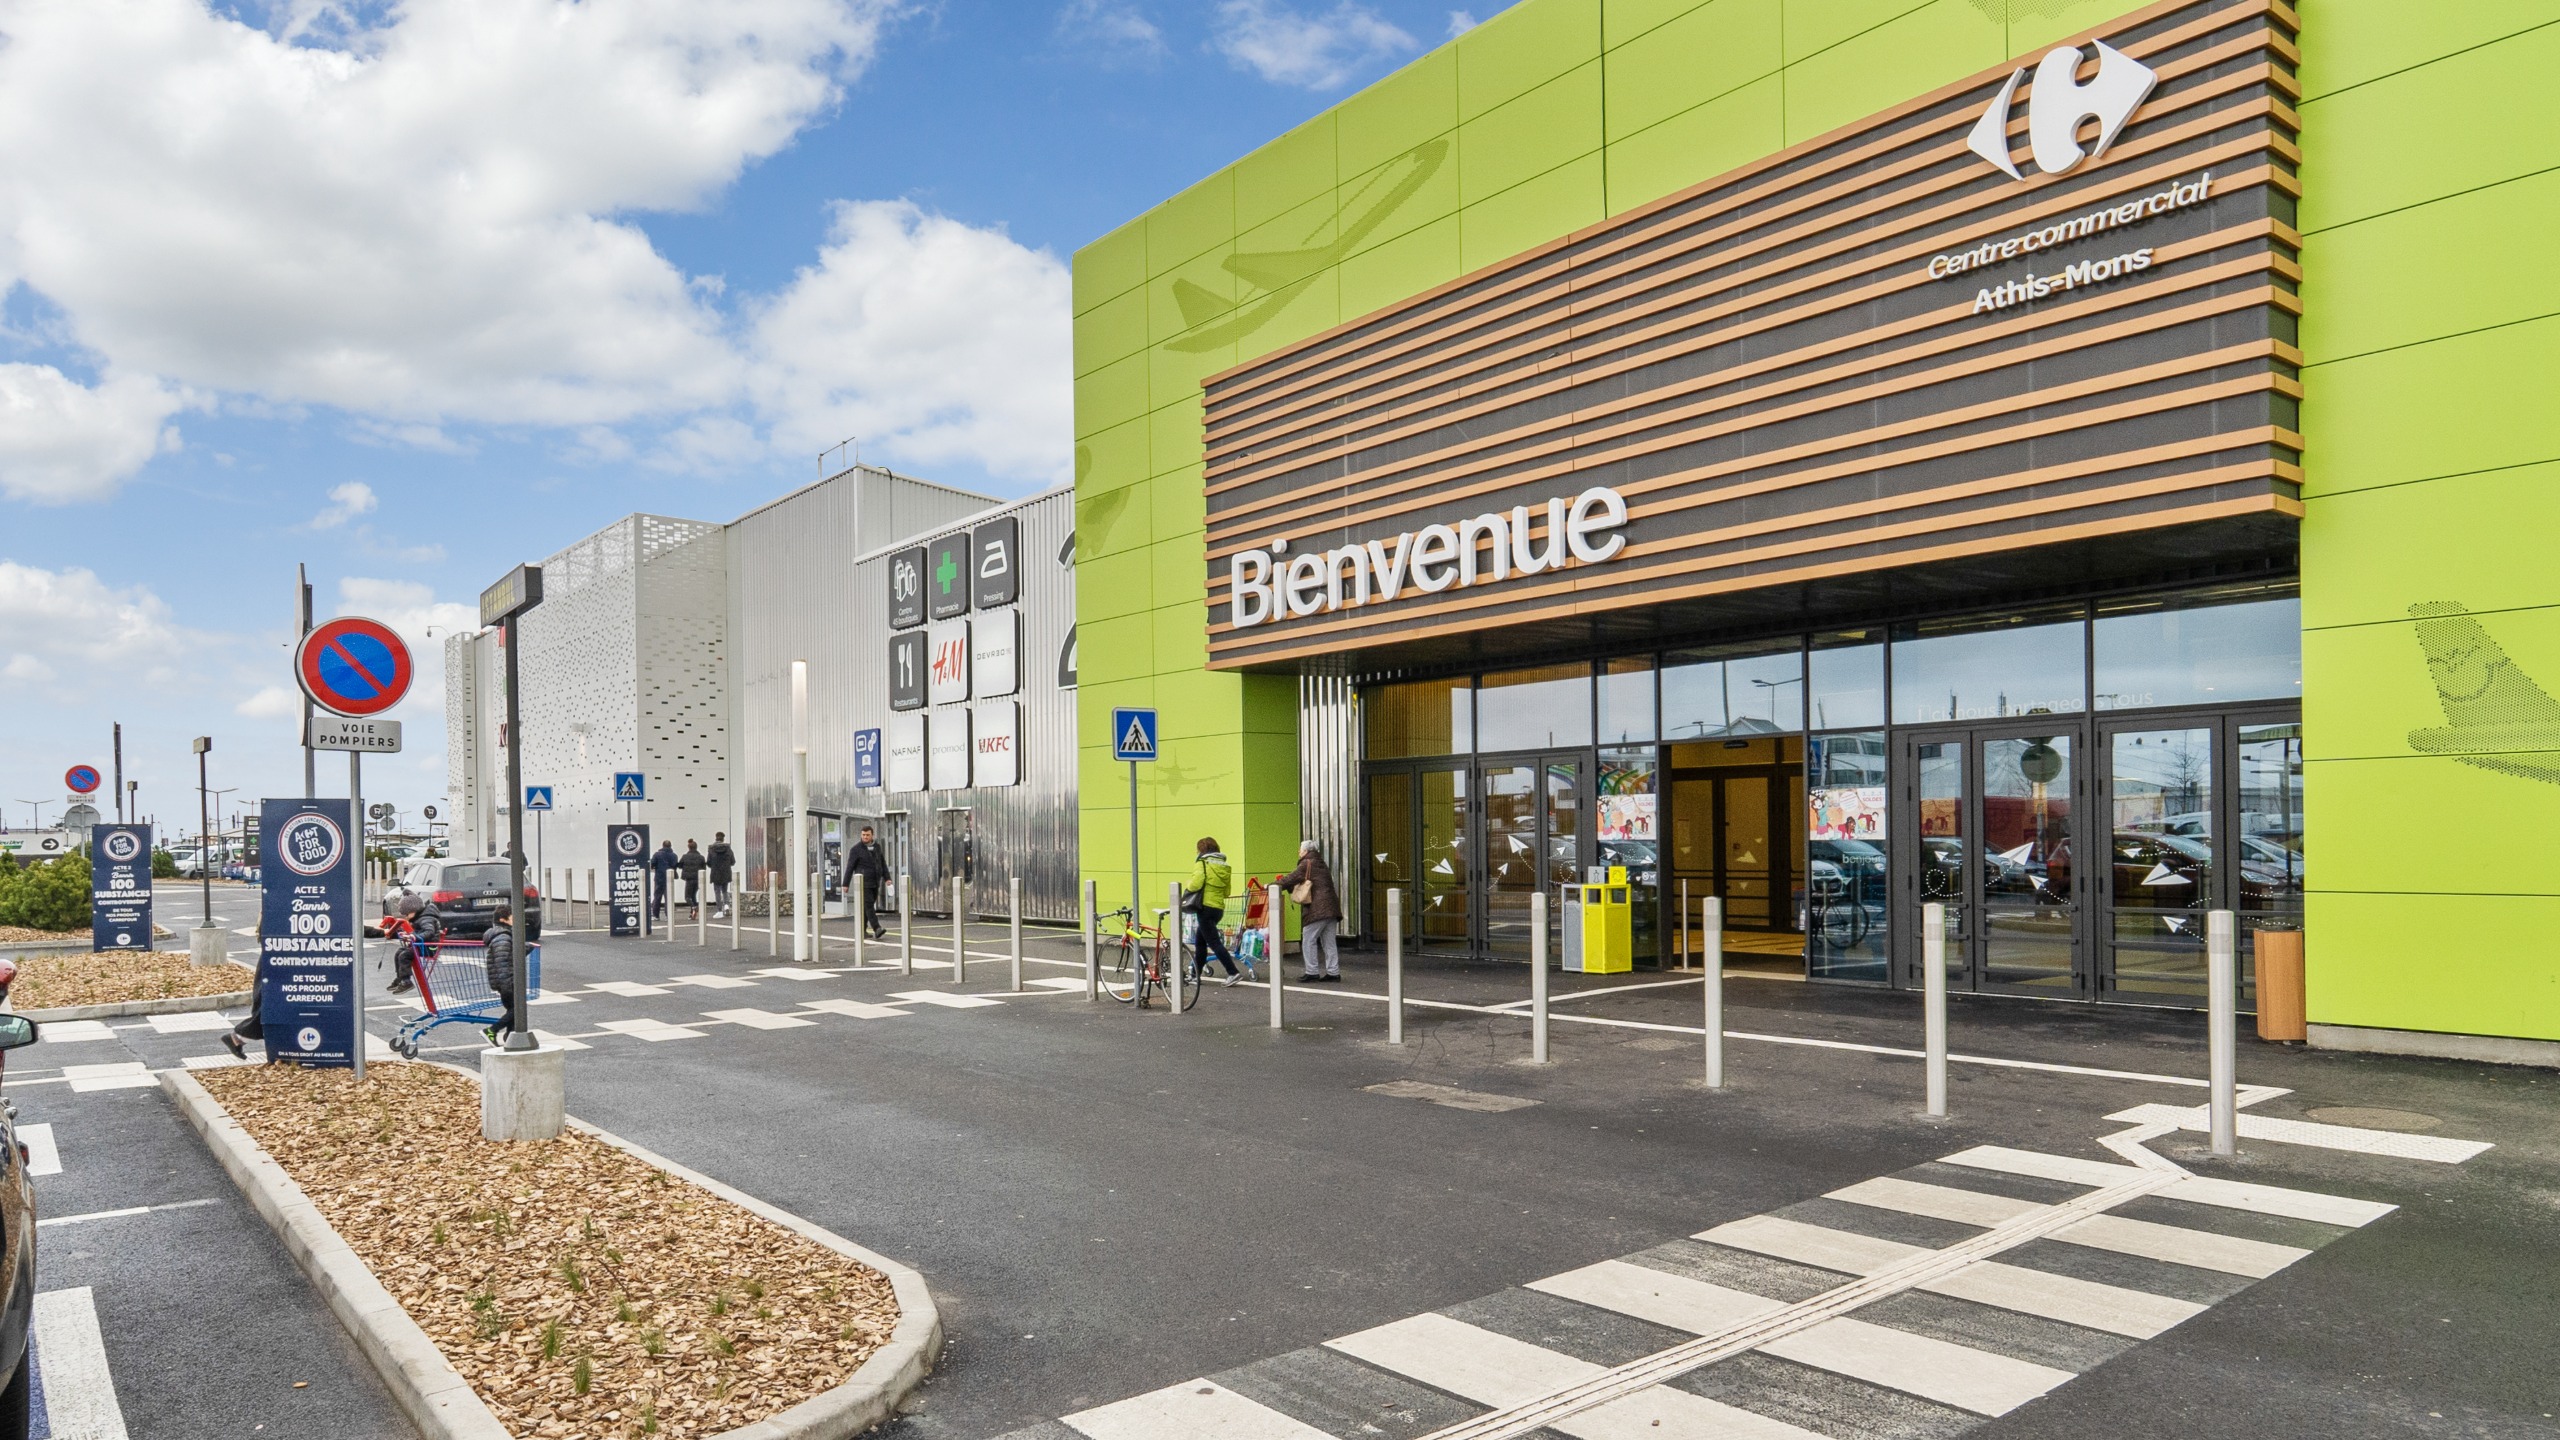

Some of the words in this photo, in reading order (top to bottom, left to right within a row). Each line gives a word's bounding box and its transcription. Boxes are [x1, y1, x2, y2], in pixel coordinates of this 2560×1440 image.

[1928, 237, 2019, 280] Centre
[2022, 172, 2210, 252] commercial
[1972, 247, 2154, 314] Athis-Mons
[1231, 486, 1628, 628] Bienvenue
[983, 591, 1004, 603] Pressing
[898, 607, 913, 616] Centre
[936, 603, 959, 615] Pharmacie
[932, 637, 964, 686] H&M
[2002, 695, 2105, 717] partageos
[341, 724, 375, 734] VOIE
[320, 735, 395, 747] POMPIERS
[985, 736, 1010, 753] KFC
[932, 743, 965, 756] promod
[299, 837, 321, 852] FOR
[299, 846, 328, 862] FOOD
[1842, 853, 1882, 866] bonjour
[110, 879, 135, 890] 100
[294, 886, 319, 894] ACTE
[320, 886, 326, 894] 2
[94, 890, 151, 898] SUBSTANCES
[614, 890, 639, 898] FRANÇA
[291, 899, 331, 912] Bannir
[289, 914, 331, 935] 100
[282, 984, 298, 992] NOS
[298, 984, 339, 992] PRODUITS
[285, 994, 334, 1002] CARREFOUR
